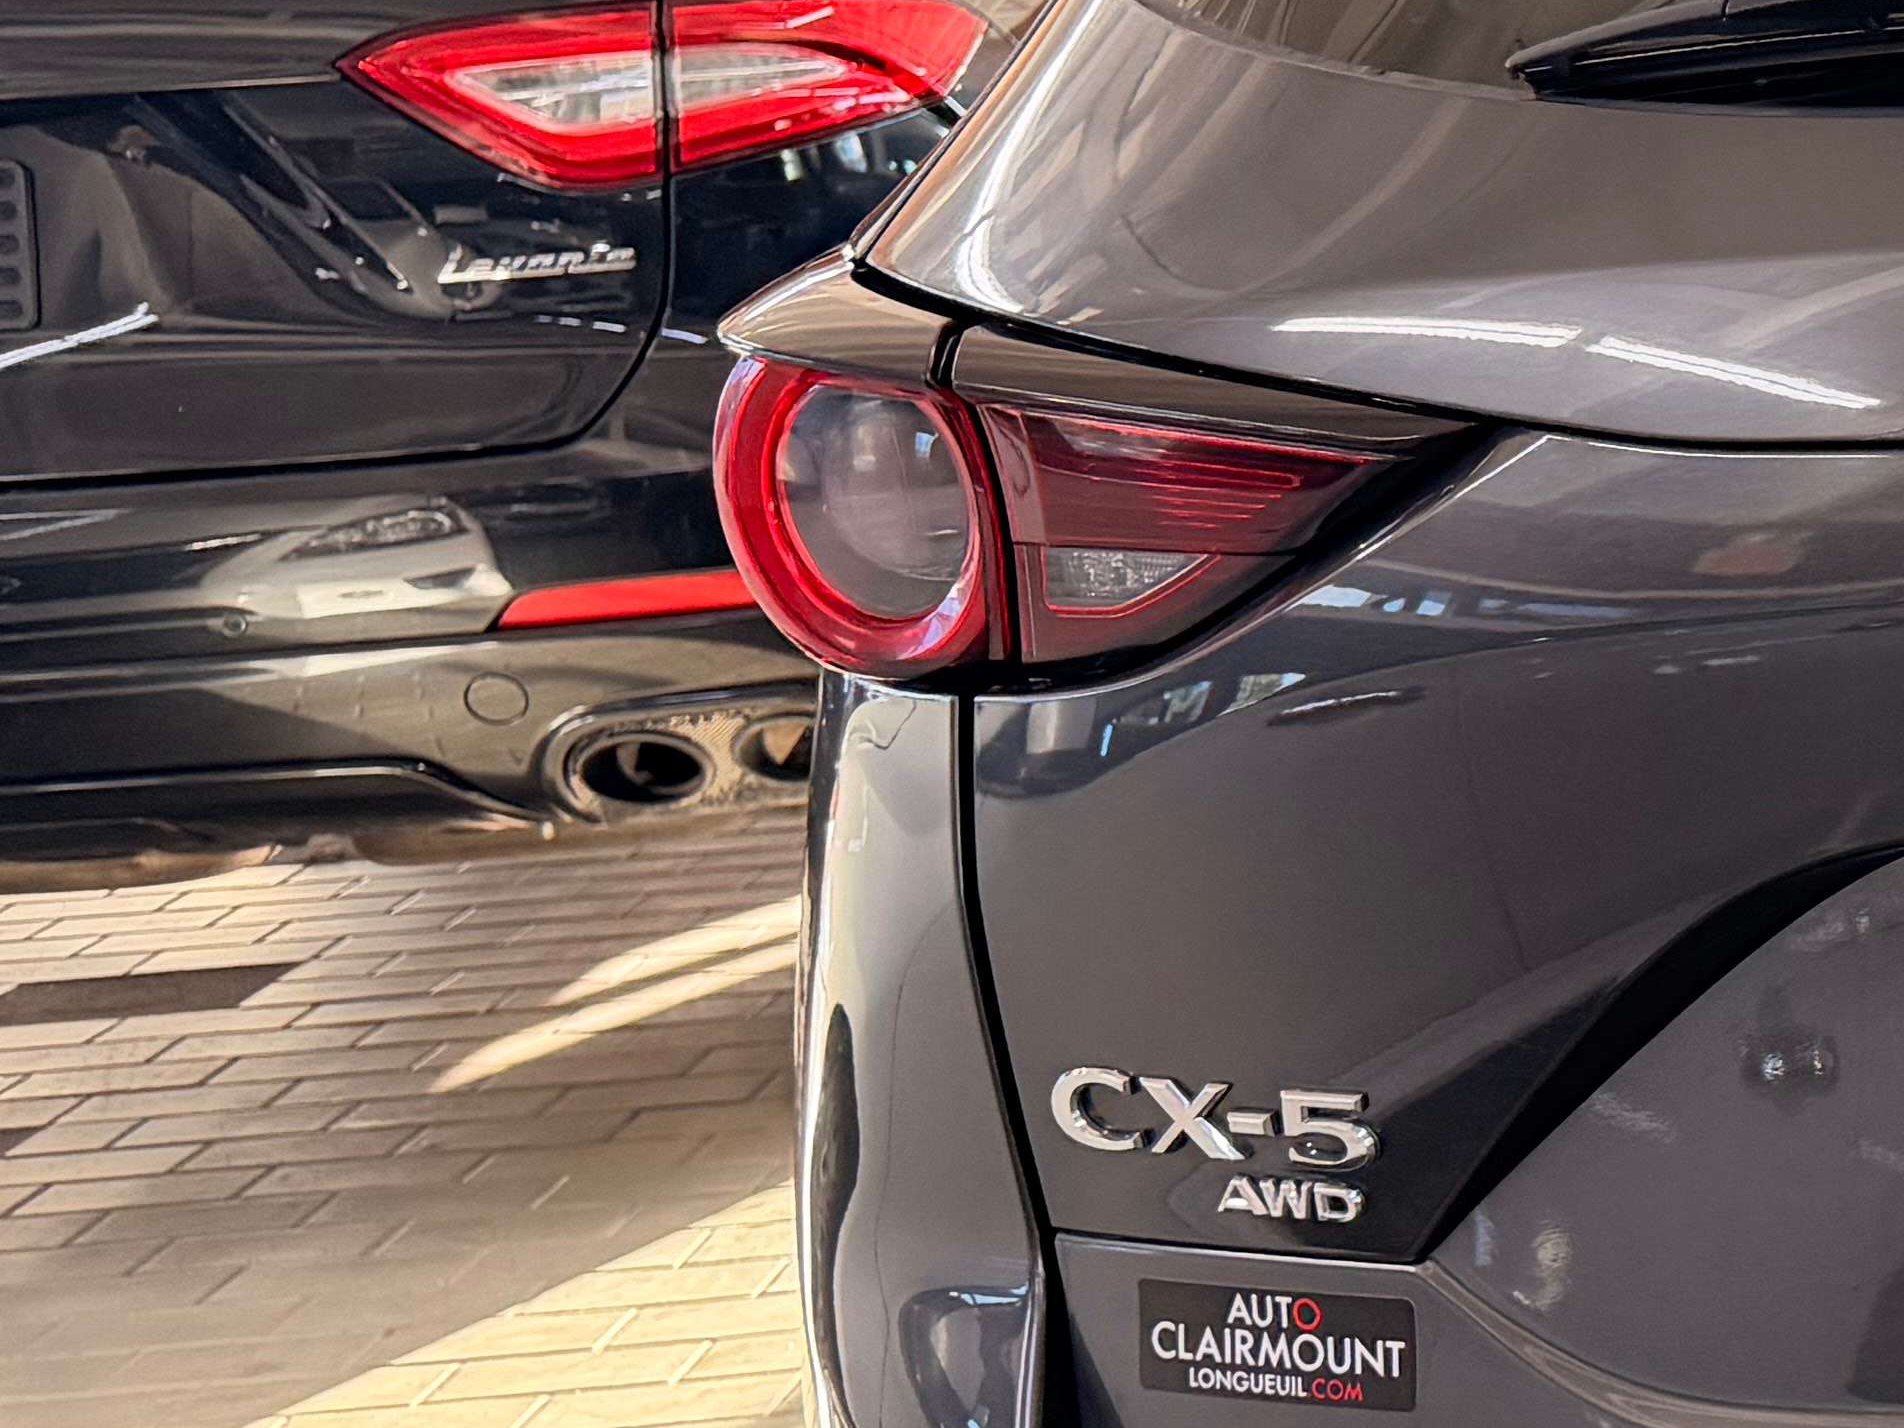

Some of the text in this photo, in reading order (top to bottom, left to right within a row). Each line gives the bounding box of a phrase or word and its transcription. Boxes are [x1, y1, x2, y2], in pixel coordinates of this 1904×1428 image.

[1050, 1065, 1381, 1171] CX-5
[1217, 1175, 1366, 1223] AWD
[1227, 1292, 1322, 1331] AUTO
[1151, 1321, 1406, 1378] CLAIRMOUNT
